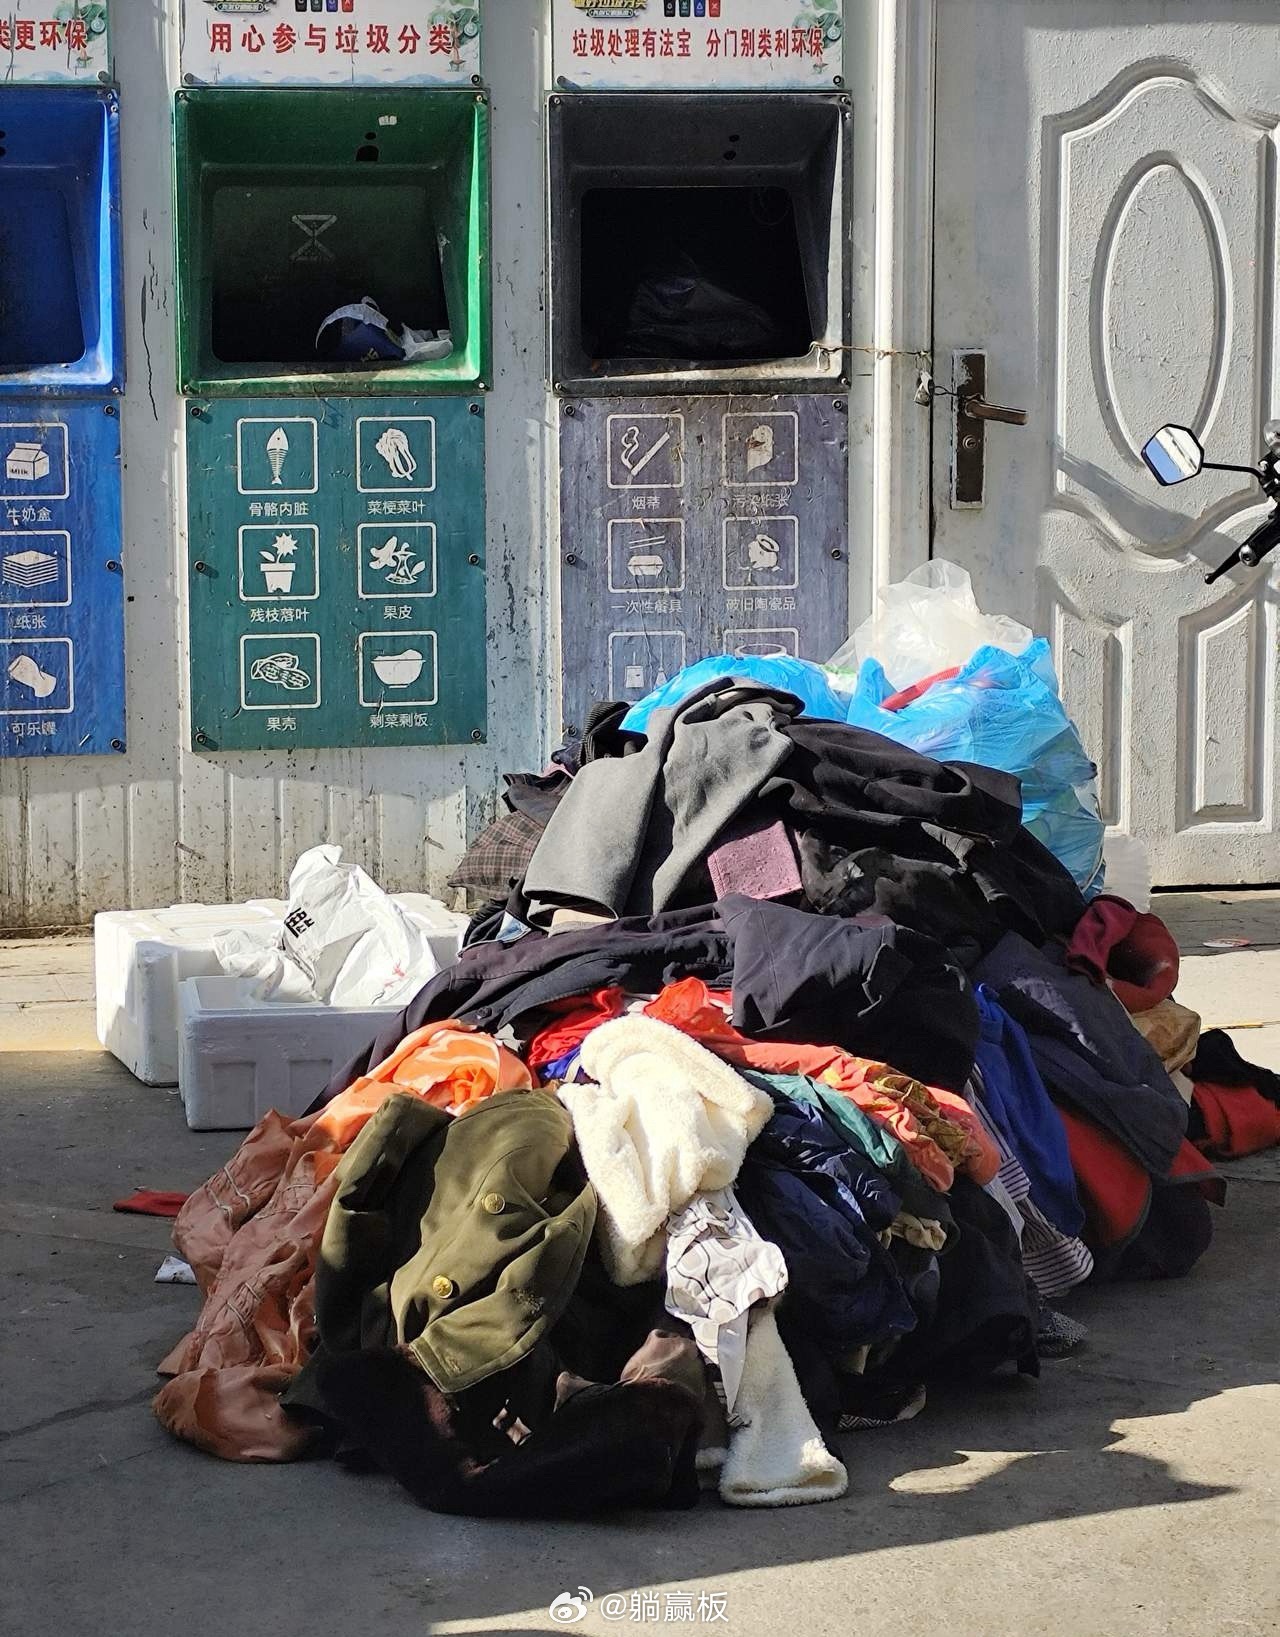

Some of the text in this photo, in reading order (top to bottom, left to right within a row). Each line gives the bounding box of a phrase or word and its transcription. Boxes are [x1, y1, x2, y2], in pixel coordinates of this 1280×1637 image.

[210, 22, 454, 54] 用心参与垃圾分类
[573, 28, 824, 58] 垃圾处理有法宝 分门别类利环保
[7, 506, 52, 522] 牛奶盒
[249, 501, 309, 517] 骨骼内脏
[367, 500, 427, 515] 菜梗菜叶
[383, 604, 413, 620] 果皮
[611, 599, 683, 615] 一次性餐具
[726, 597, 797, 611] 破旧陶瓷品
[14, 614, 47, 629] 纸张
[250, 607, 311, 622] 残枝落叶
[266, 716, 297, 731] 果壳
[369, 712, 429, 728] 剩菜剩饭
